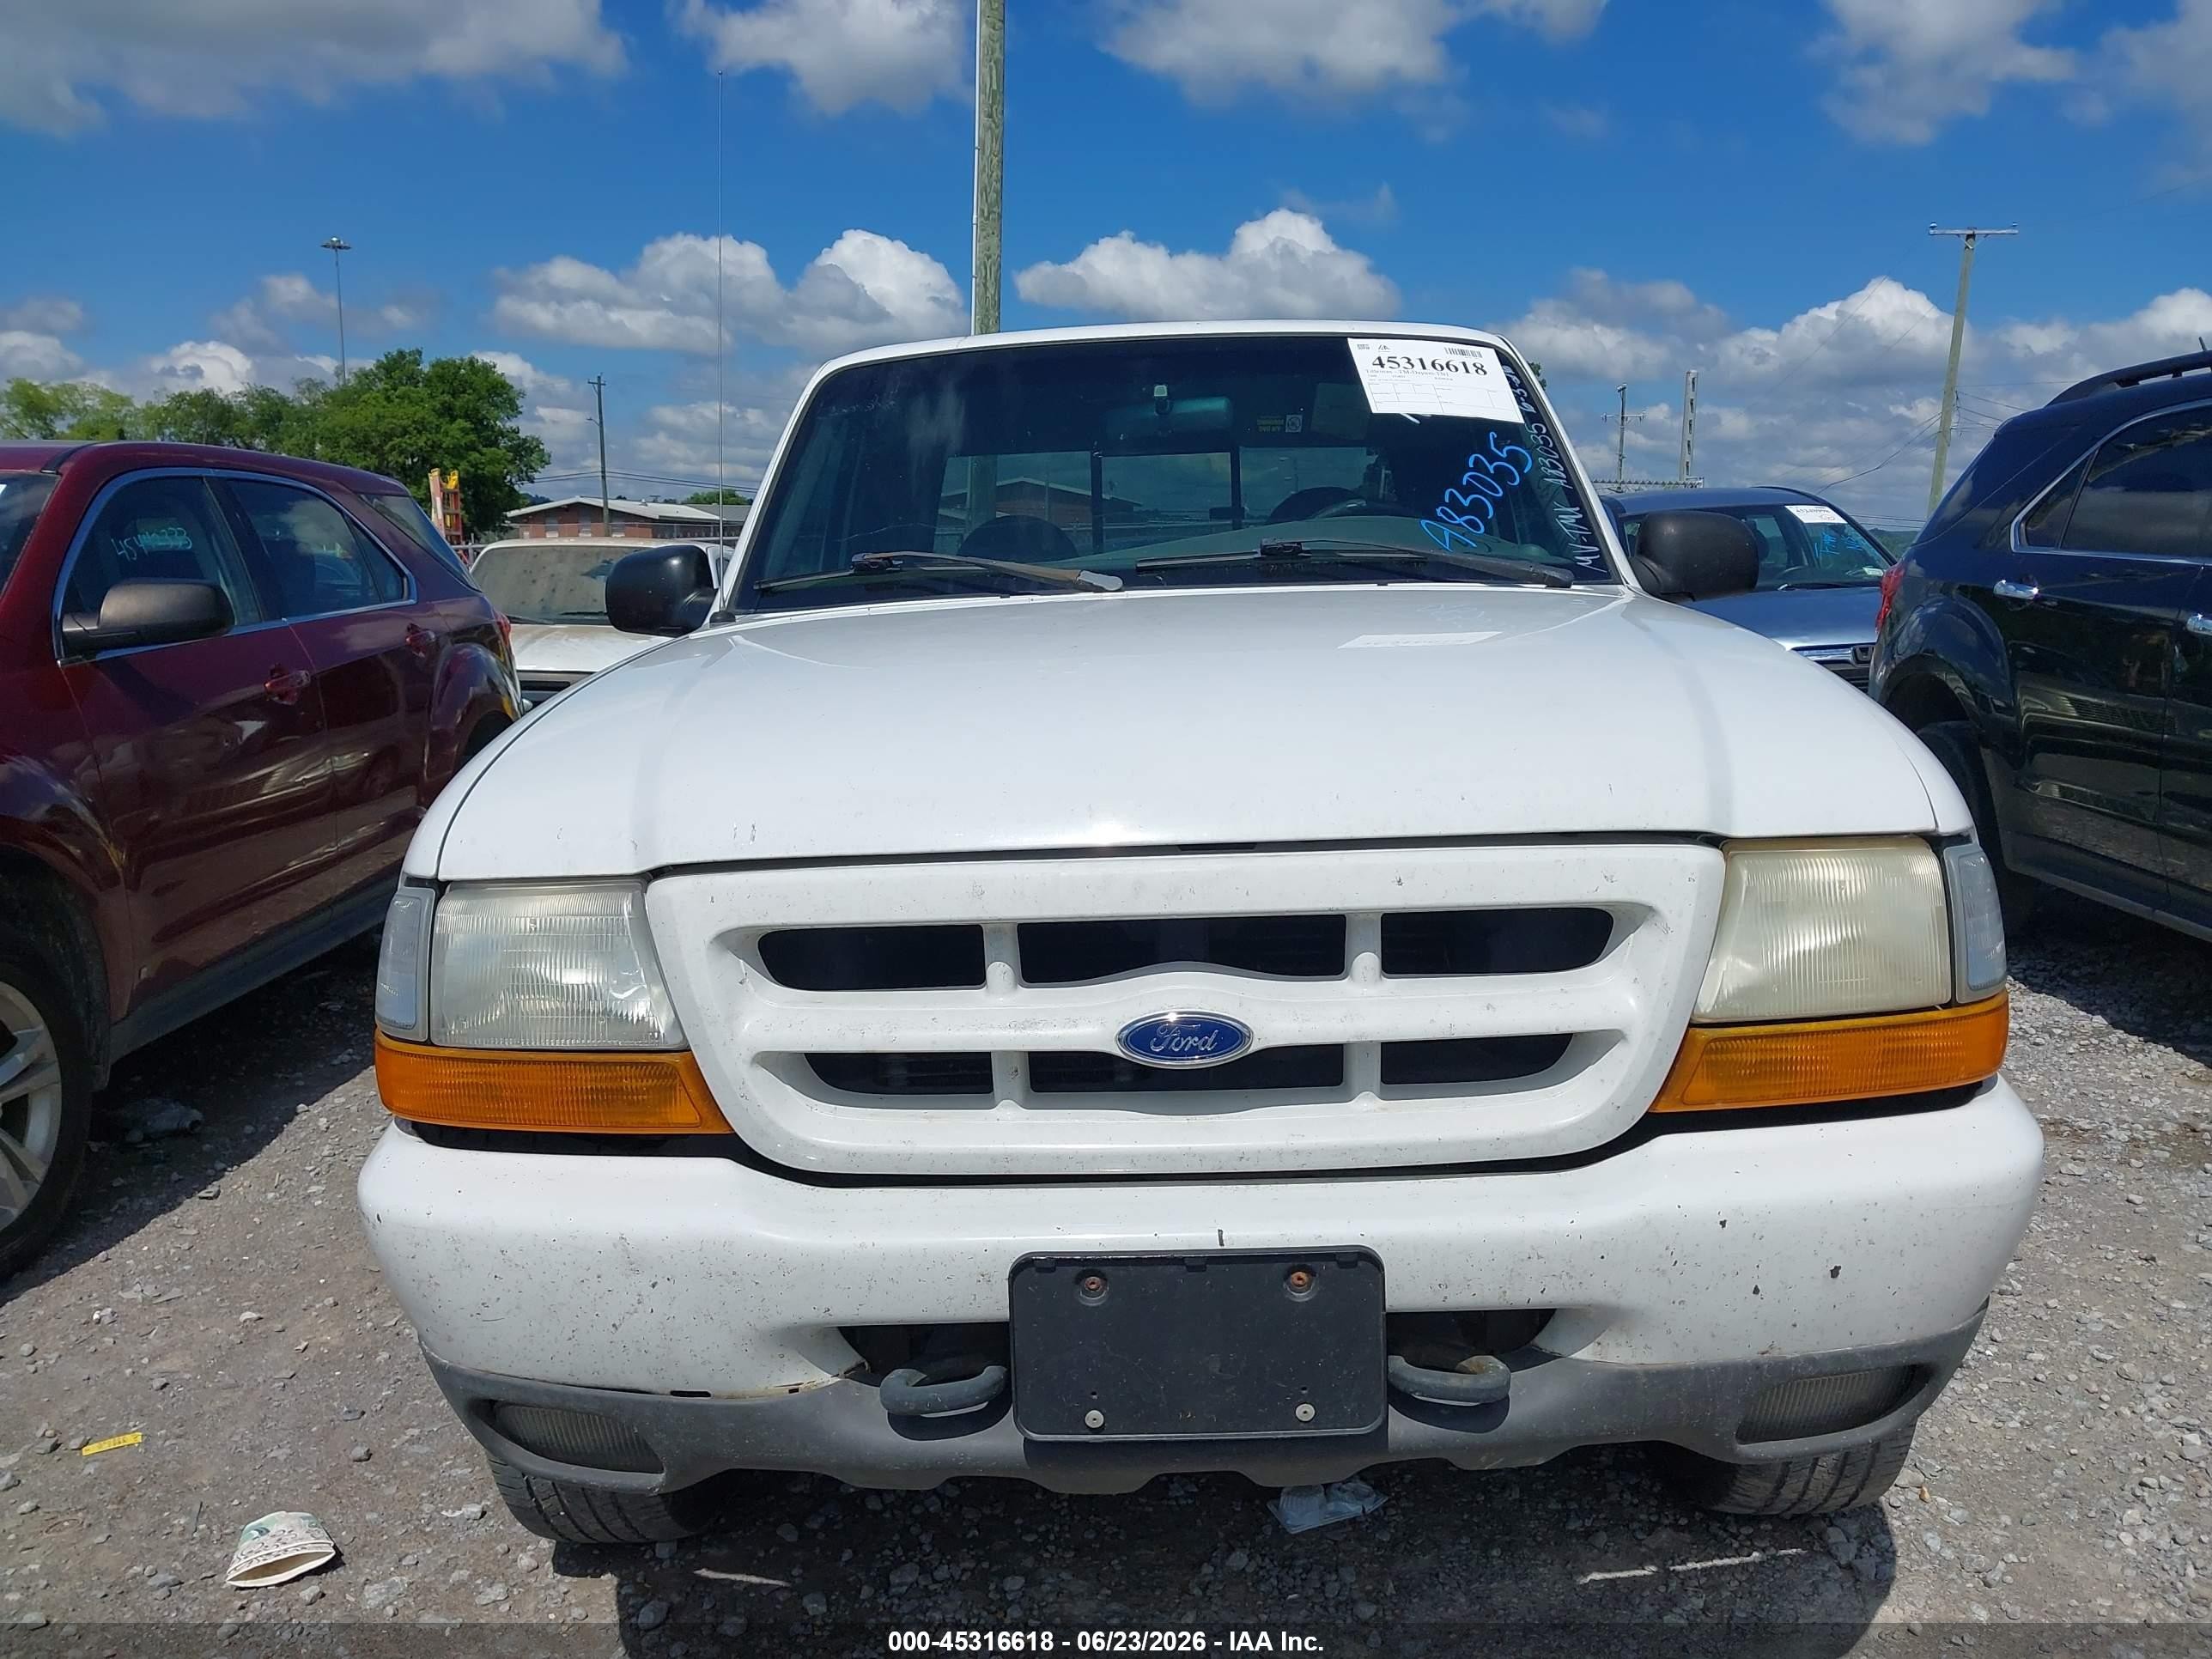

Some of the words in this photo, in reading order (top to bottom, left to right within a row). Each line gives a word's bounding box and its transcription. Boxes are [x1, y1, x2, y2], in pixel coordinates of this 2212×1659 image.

[1372, 356, 1488, 376] 45316618
[1524, 422, 1574, 489] A83035
[1420, 431, 1533, 552] A83035
[1149, 1023, 1219, 1052] Ford
